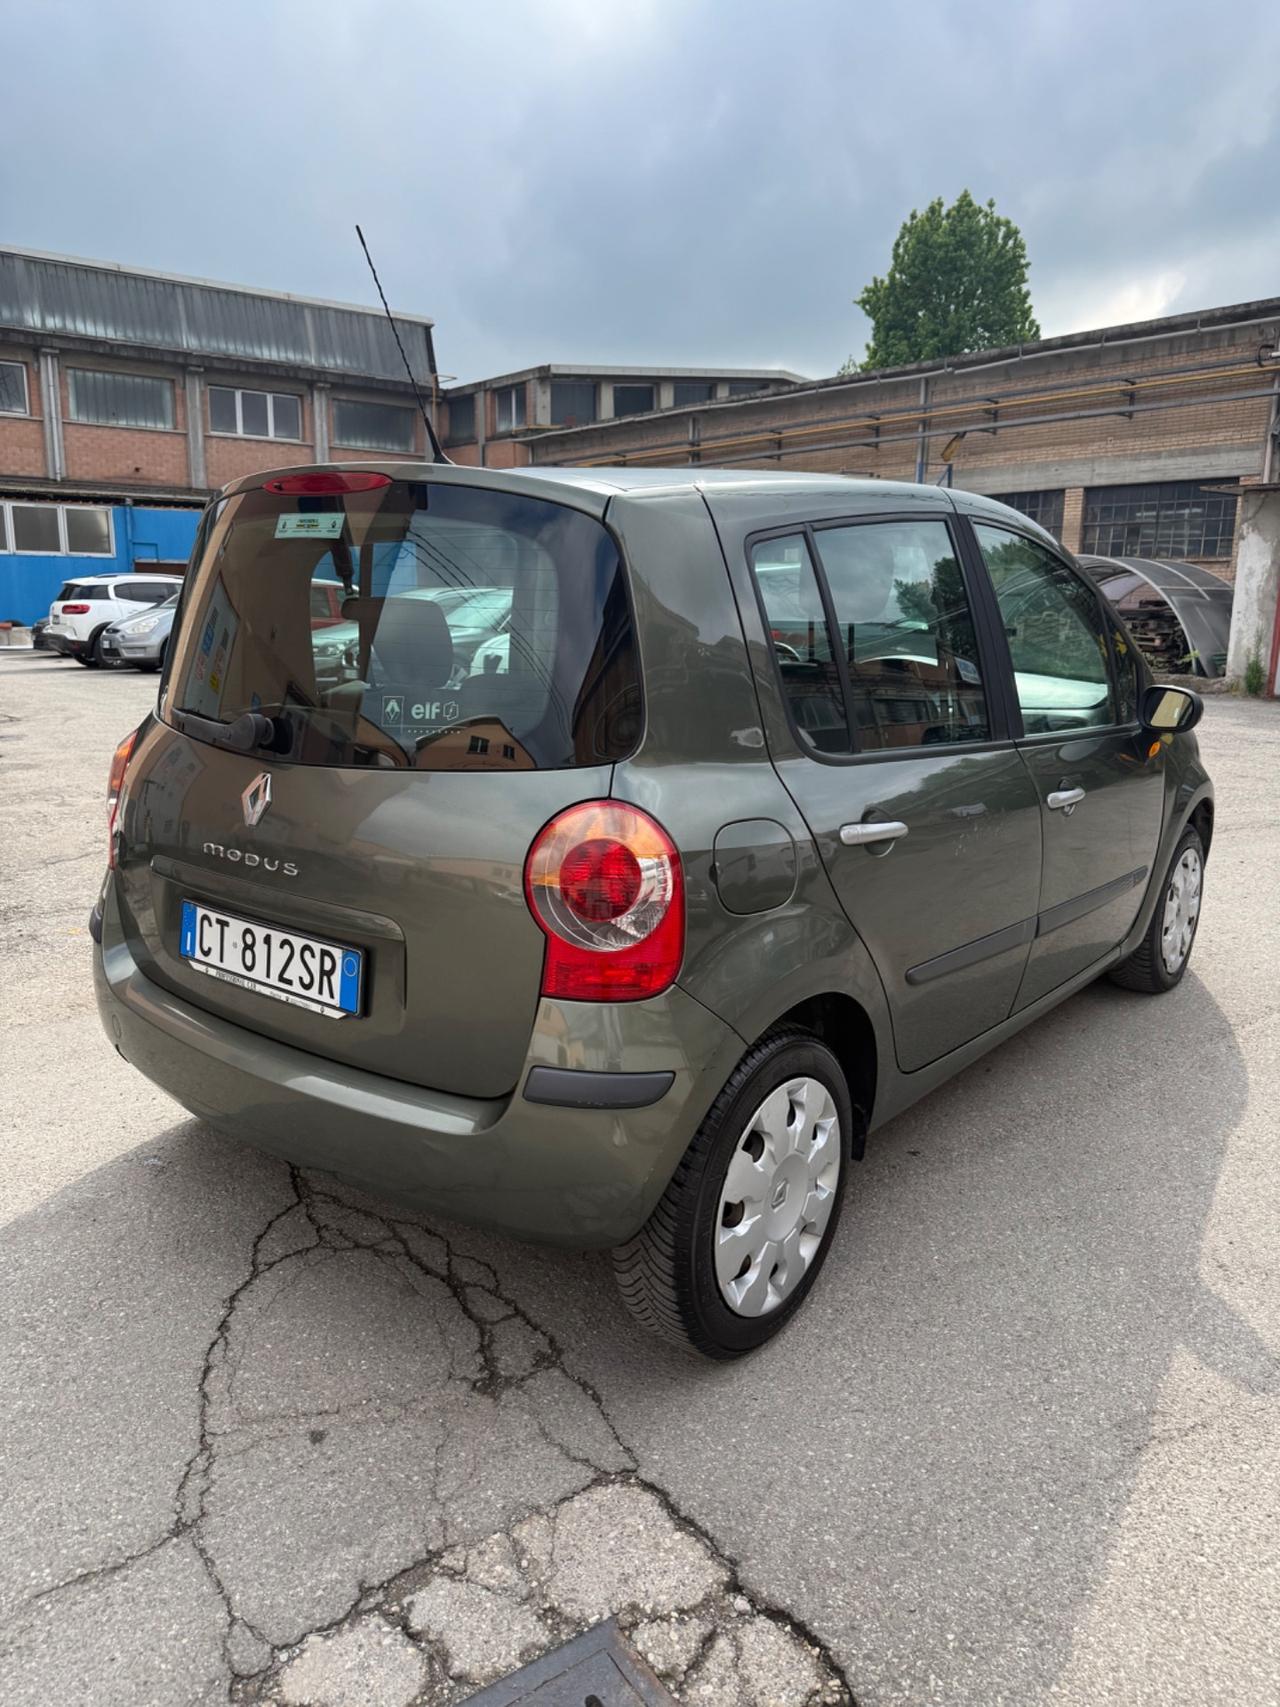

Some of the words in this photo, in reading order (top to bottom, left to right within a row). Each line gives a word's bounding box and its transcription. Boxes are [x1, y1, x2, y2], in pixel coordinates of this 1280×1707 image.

[411, 702, 441, 719] elf
[203, 842, 298, 876] MODUS
[186, 931, 191, 951] I
[199, 913, 230, 963] CT
[241, 927, 335, 999] 812SR
